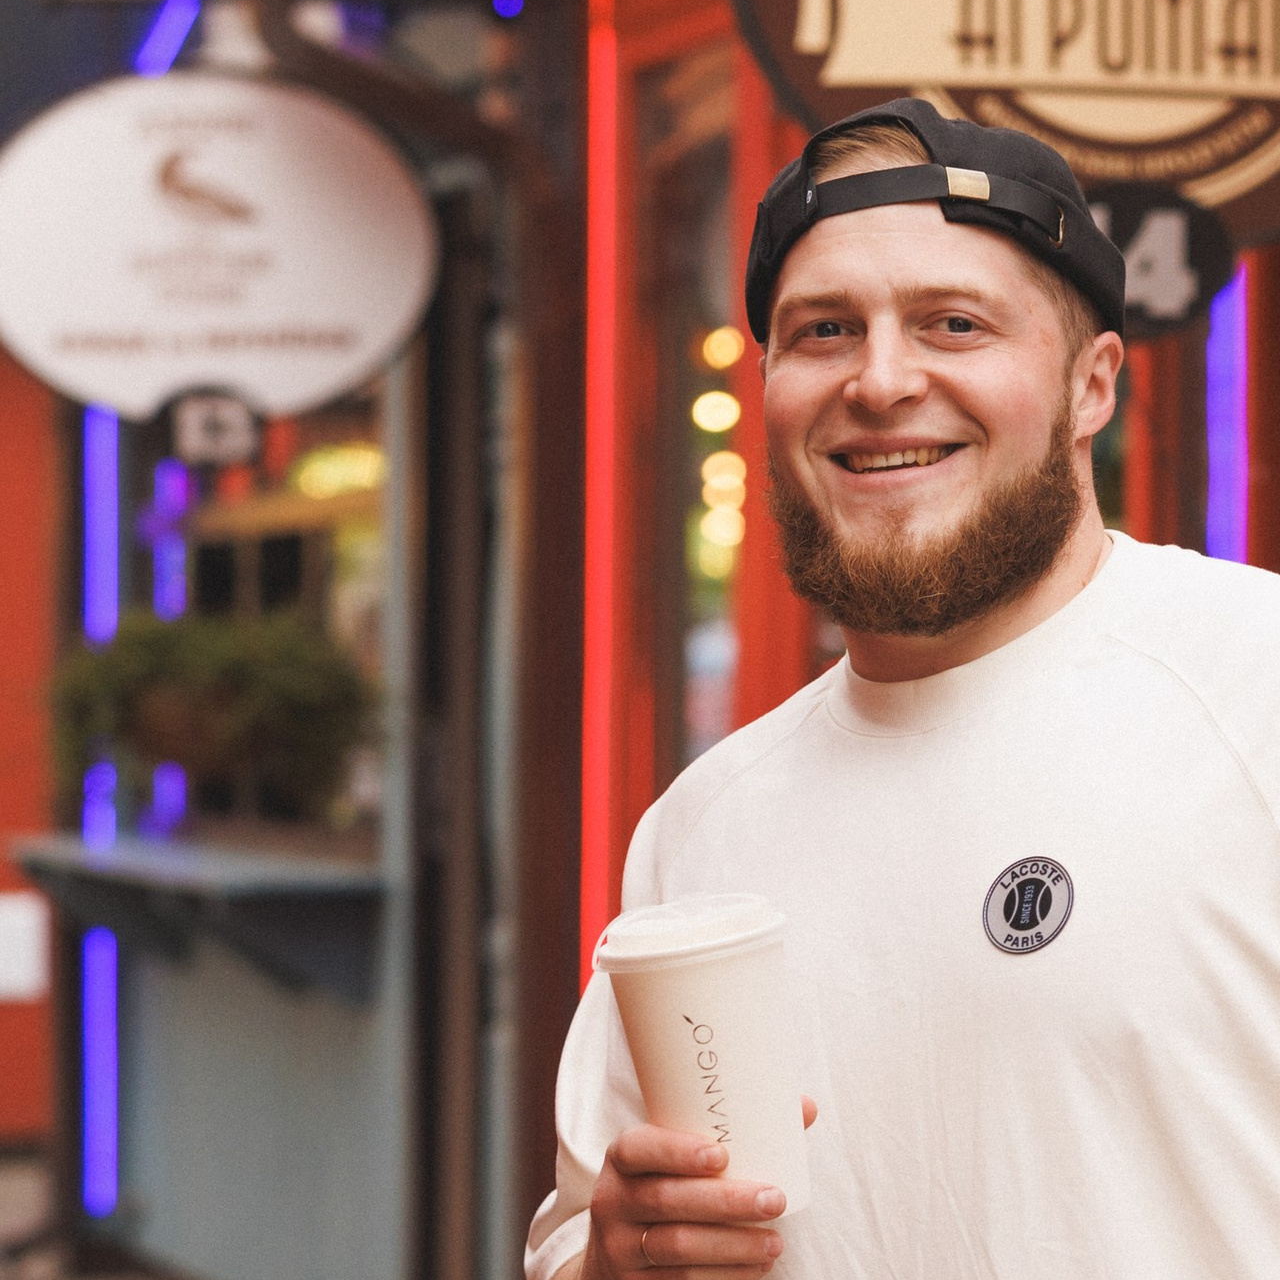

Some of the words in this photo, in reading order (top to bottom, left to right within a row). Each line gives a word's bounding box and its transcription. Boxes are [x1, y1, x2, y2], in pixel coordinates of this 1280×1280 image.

[1000, 862, 1063, 889] LACOSTE
[1024, 884, 1035, 902] 1933
[1020, 903, 1032, 924] SINCE
[1003, 931, 1044, 948] PARIS
